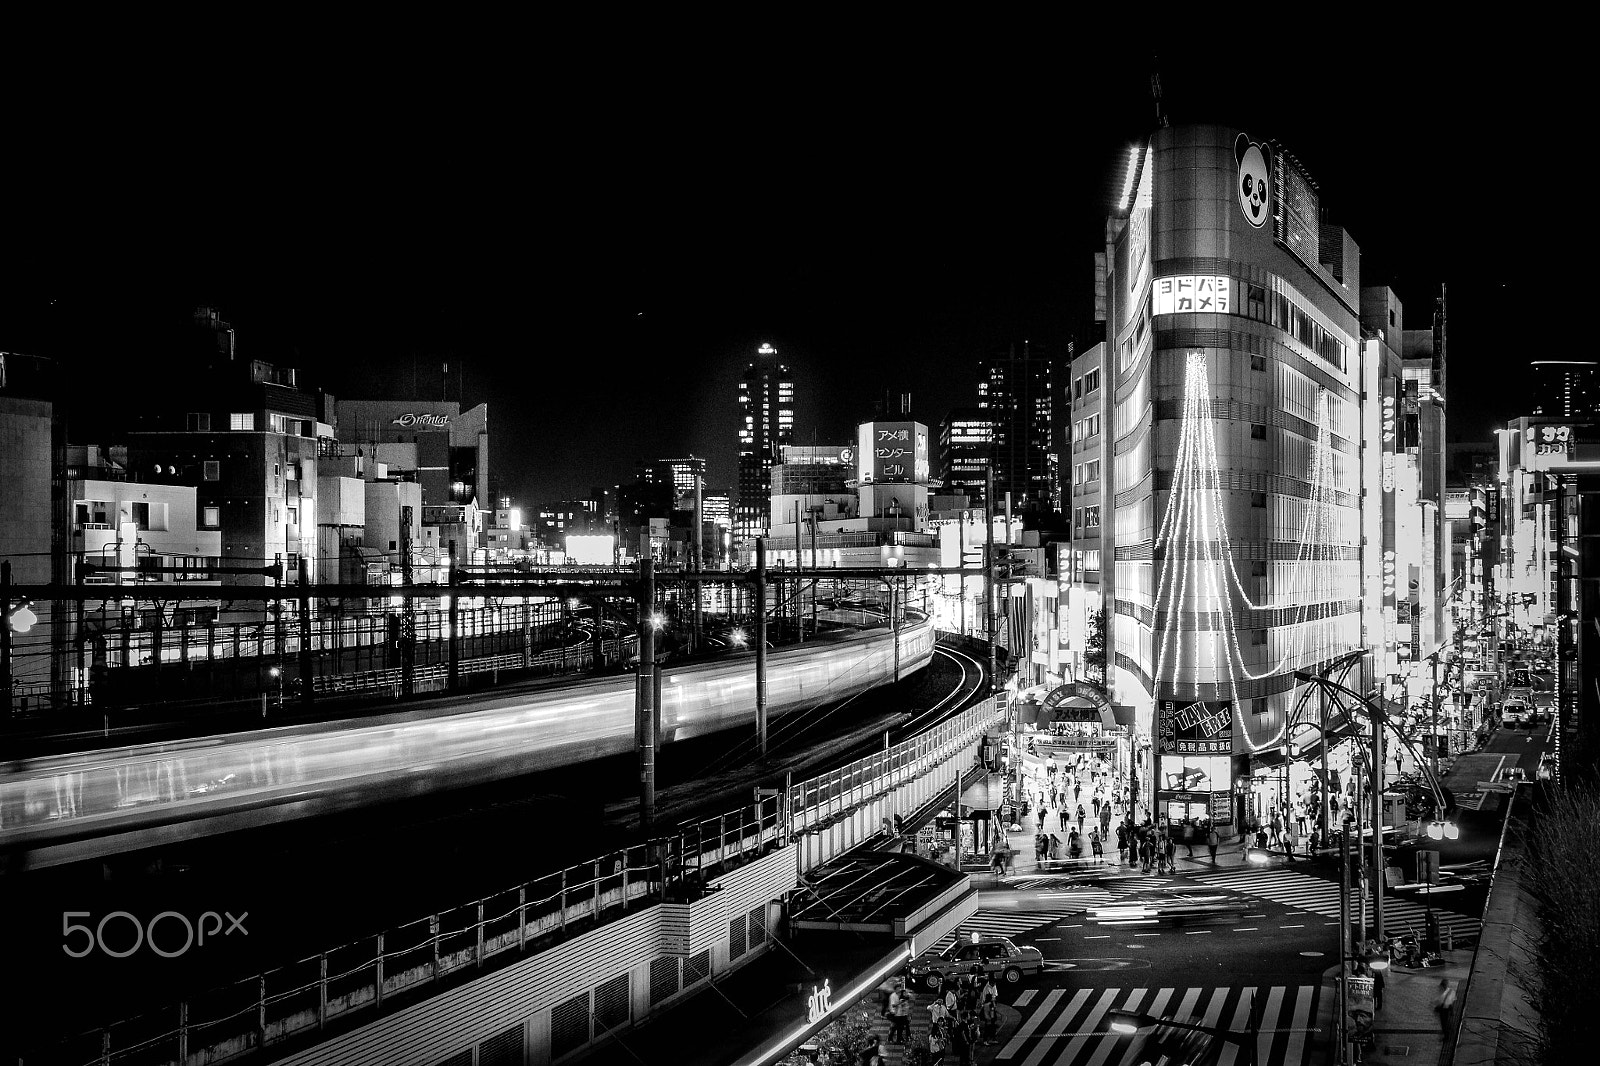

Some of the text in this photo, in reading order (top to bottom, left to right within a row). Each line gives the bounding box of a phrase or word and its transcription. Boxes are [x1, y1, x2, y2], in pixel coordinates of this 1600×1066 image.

[1162, 279, 1227, 294] ヨドバシ
[1178, 297, 1227, 311] カメラ
[875, 447, 913, 459] センター
[883, 464, 904, 476] ビル
[1174, 700, 1212, 731] TAX
[1200, 707, 1232, 738] FREE
